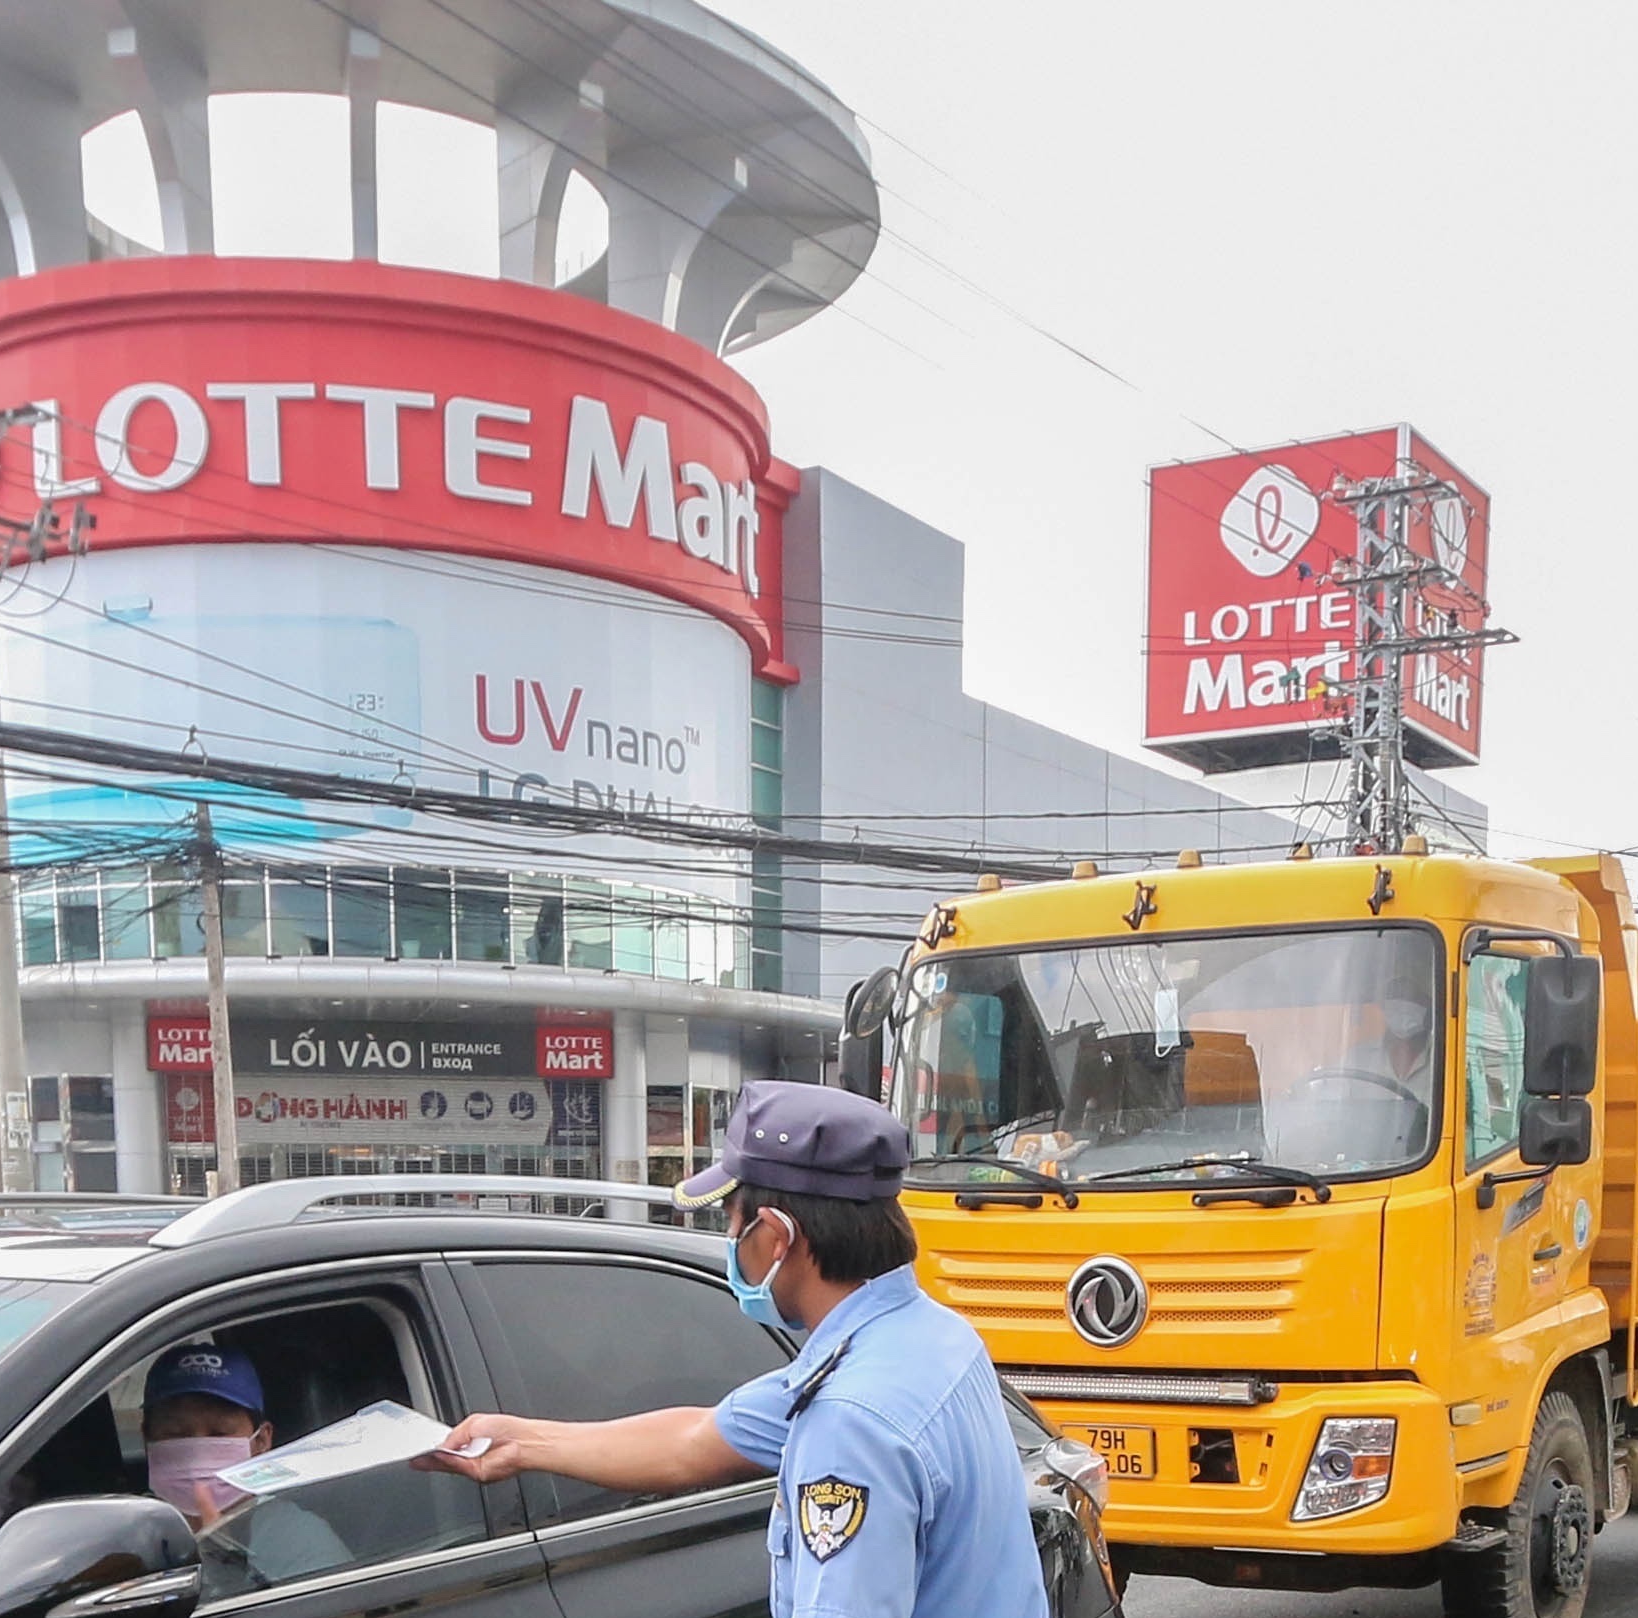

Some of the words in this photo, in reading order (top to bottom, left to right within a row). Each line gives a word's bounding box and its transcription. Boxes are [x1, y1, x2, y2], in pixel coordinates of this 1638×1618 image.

[31, 382, 533, 506] LOTTE
[560, 395, 759, 599] Mart
[1184, 591, 1351, 647] LOTTE
[1182, 640, 1351, 715] Mart
[1414, 653, 1470, 731] Mart
[157, 1028, 211, 1041] LOTT
[545, 1036, 602, 1049] LOTTE
[158, 1043, 215, 1063] Mar
[269, 1028, 326, 1067] LỐI
[337, 1032, 412, 1069] VÀO
[431, 1042, 502, 1055] ENTRANCE
[545, 1050, 603, 1070] Mart
[1087, 1429, 1126, 1450] 79H
[804, 1482, 832, 1497] LONG
